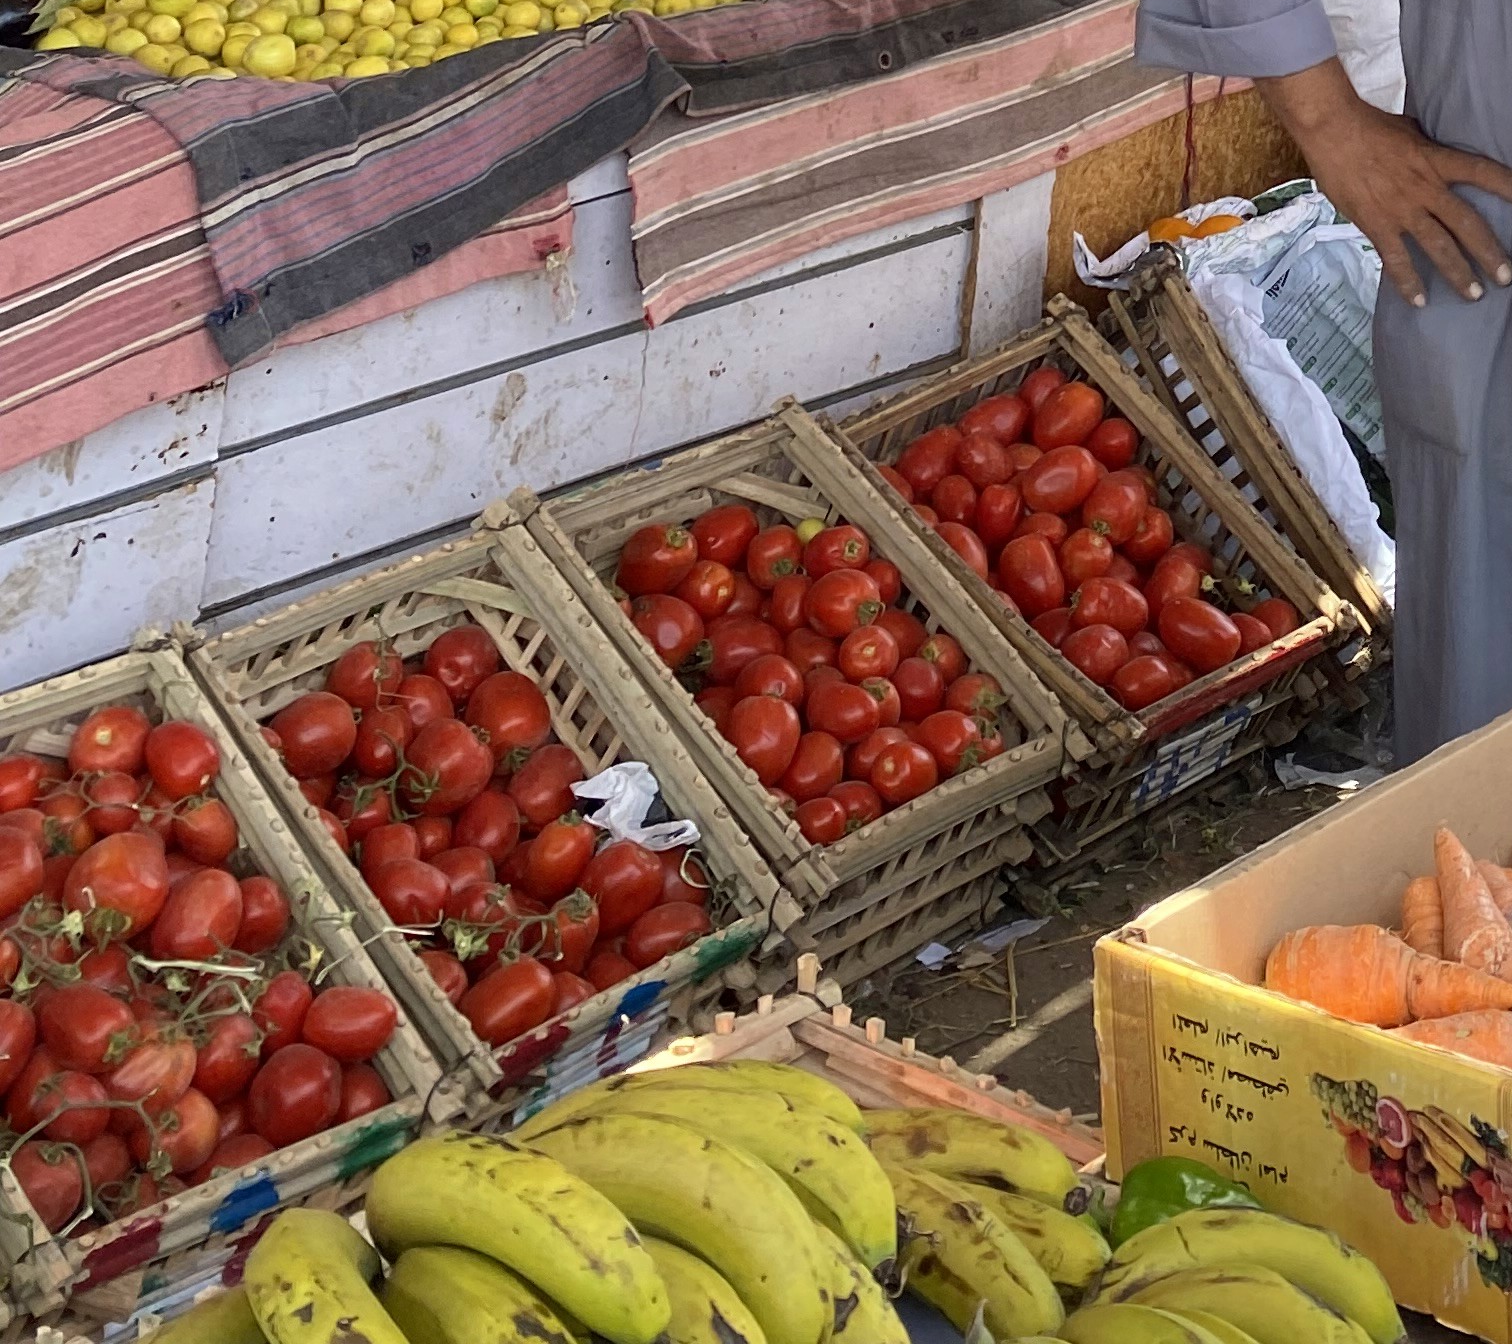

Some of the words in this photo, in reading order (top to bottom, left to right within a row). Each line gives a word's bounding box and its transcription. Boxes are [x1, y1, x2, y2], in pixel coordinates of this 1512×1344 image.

[1172, 1014, 1208, 1037] المعلم
[1169, 1125, 1196, 1146] كرم
[1203, 1139, 1252, 1171] سلطان
[1258, 1163, 1288, 1184] امام
